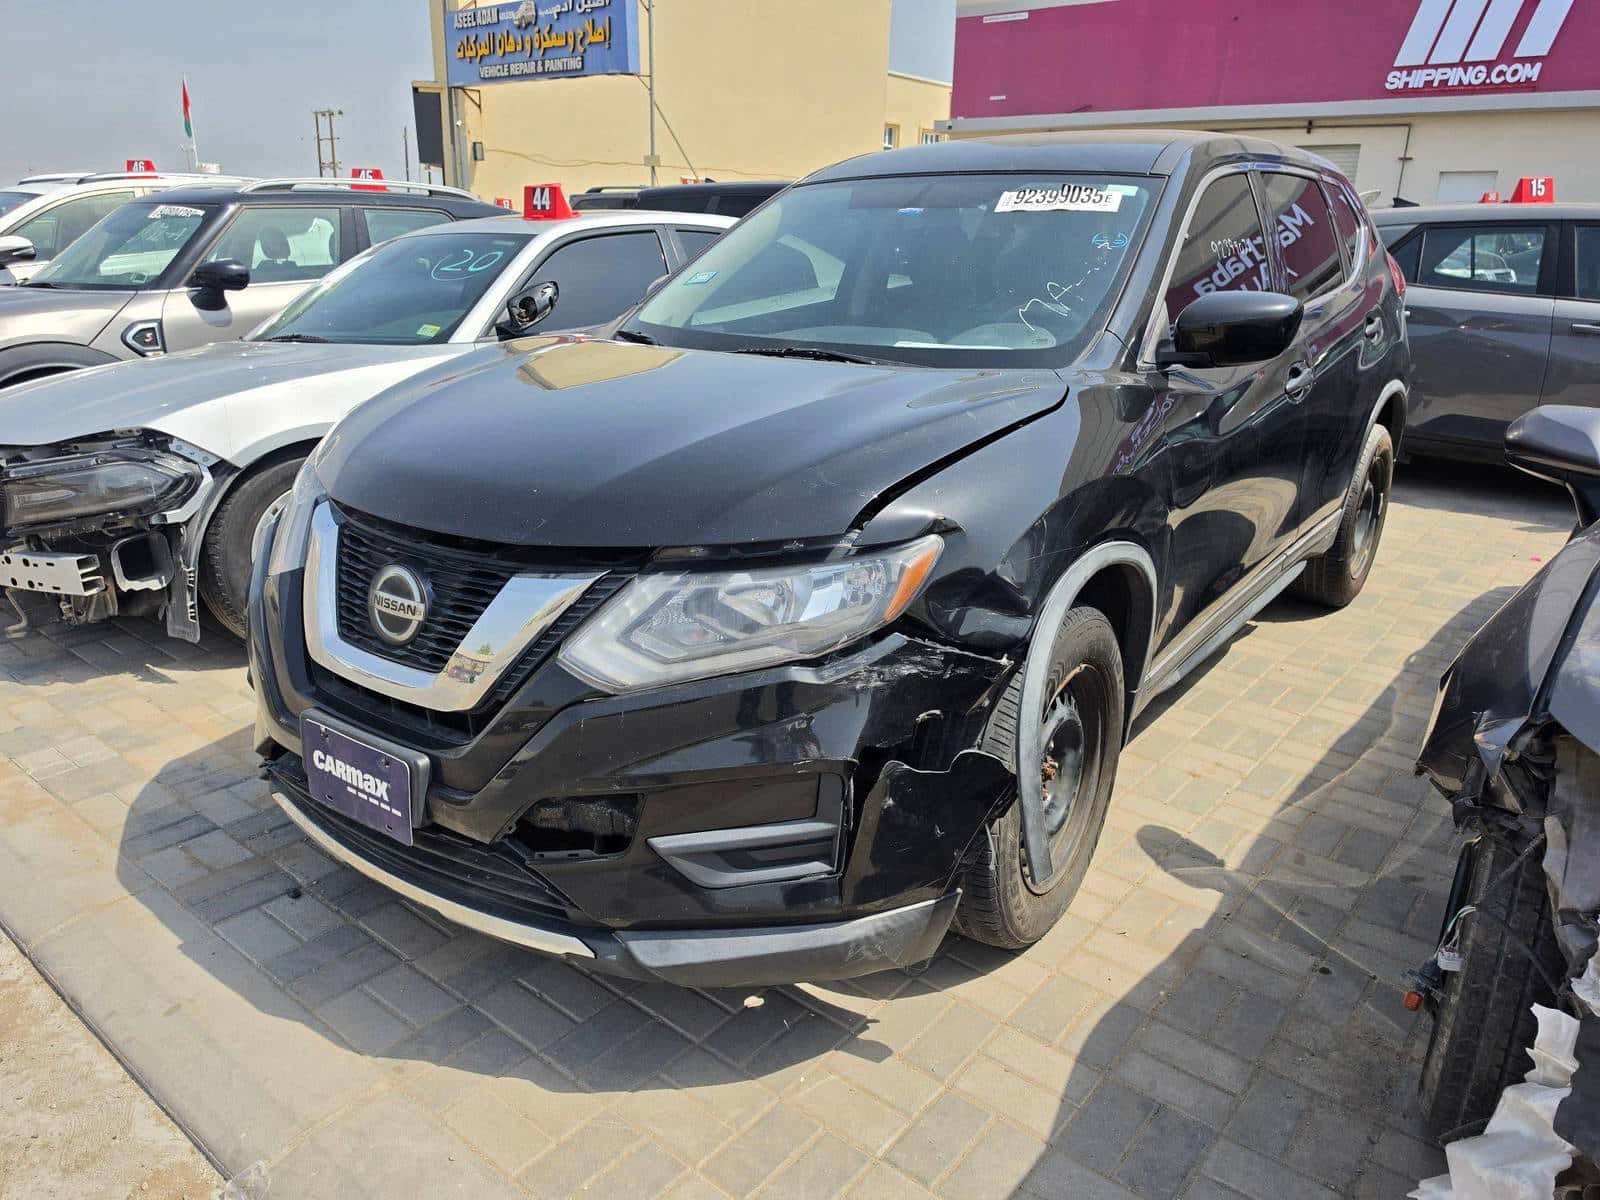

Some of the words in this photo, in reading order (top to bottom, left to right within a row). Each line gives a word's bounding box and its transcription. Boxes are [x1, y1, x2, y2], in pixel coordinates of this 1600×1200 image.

[454, 11, 477, 29] ASEEL
[477, 8, 499, 26] ADAM
[479, 64, 509, 78] VEHICLE
[509, 61, 536, 76] REPAIR
[536, 60, 544, 73] &
[544, 57, 583, 72] PAINTING
[1385, 62, 1543, 90] SHIPPING.COM
[532, 187, 550, 210] 44
[1014, 183, 1104, 205] 92399035
[1531, 178, 1546, 197] 15
[373, 593, 417, 617] NISSAN
